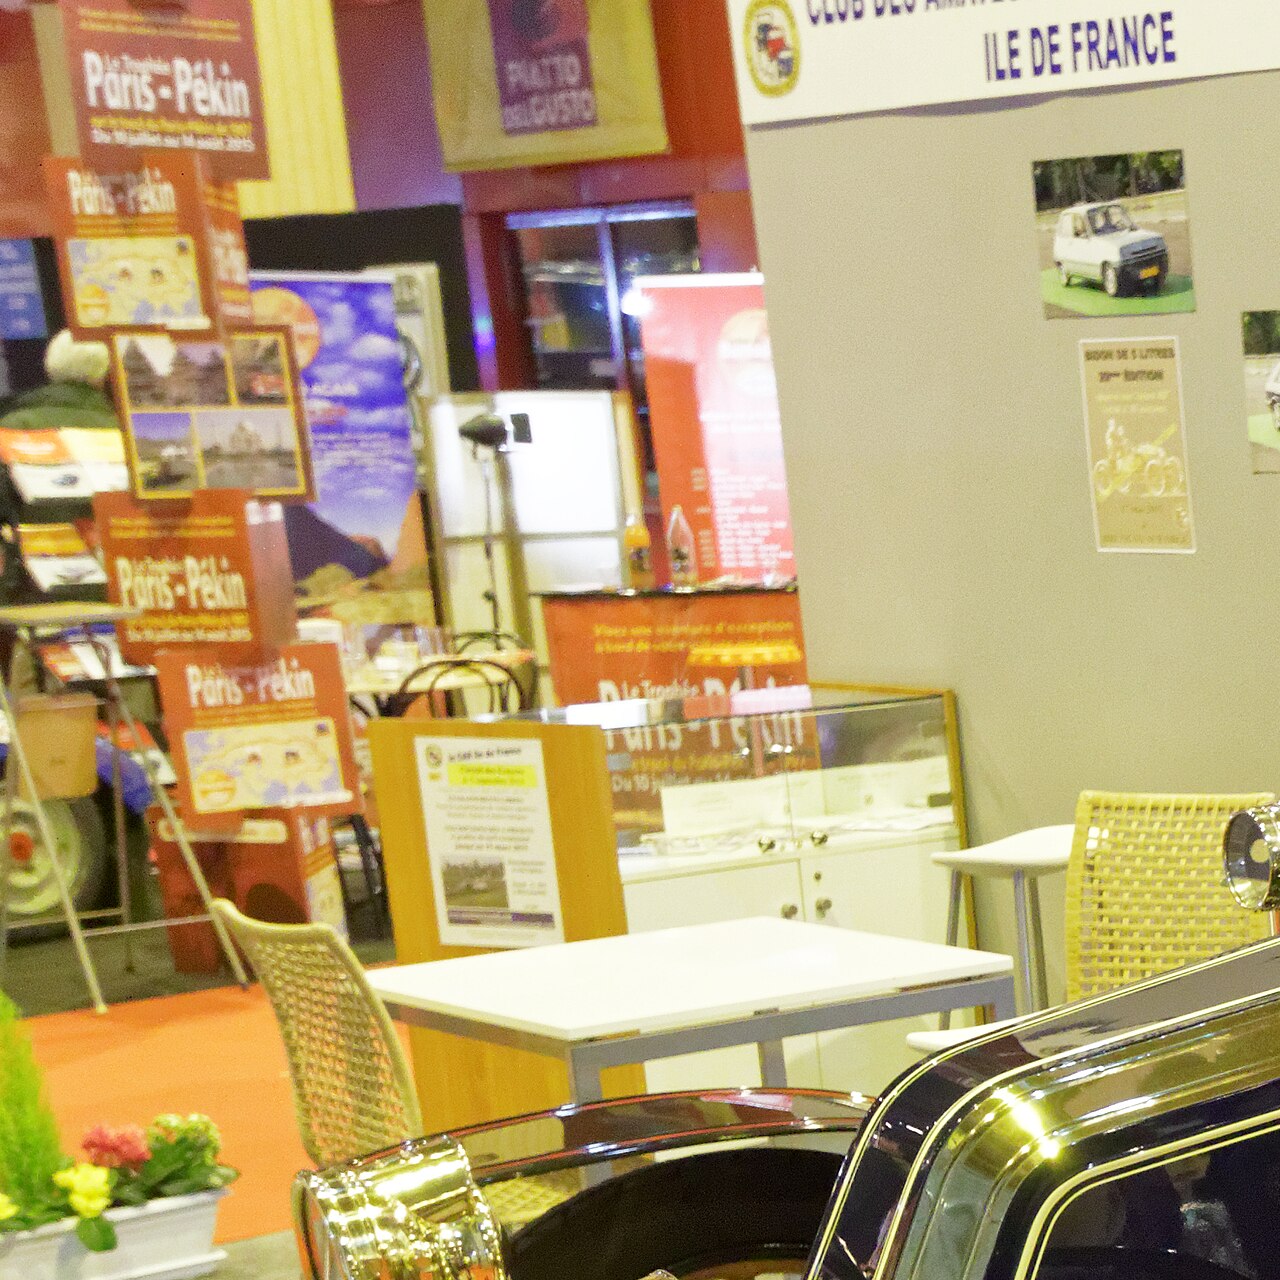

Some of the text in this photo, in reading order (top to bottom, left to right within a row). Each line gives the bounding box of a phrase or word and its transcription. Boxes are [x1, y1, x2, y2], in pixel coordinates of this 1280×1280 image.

[984, 11, 1176, 82] ILE DE FRANCE
